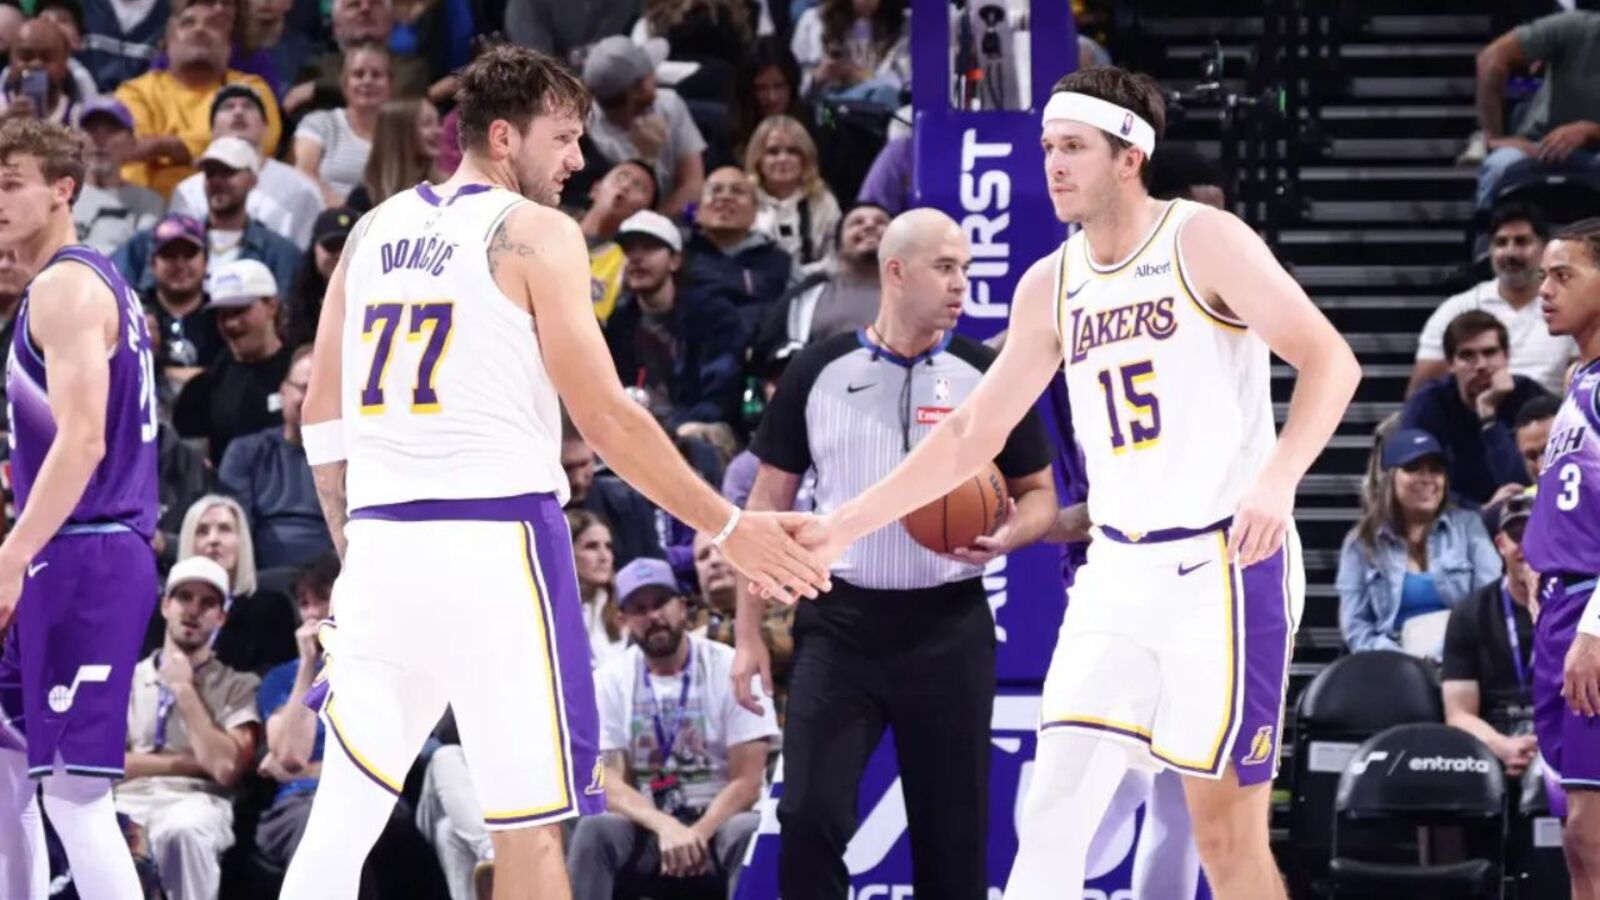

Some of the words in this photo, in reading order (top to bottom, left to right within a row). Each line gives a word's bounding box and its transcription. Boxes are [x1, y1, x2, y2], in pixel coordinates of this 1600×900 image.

[960, 128, 1013, 319] FIRST
[1134, 261, 1172, 278] Albert
[359, 299, 455, 415] 77
[1070, 296, 1178, 365] LAKERS
[1097, 359, 1162, 455] 15
[1556, 463, 1582, 511] 3
[1409, 755, 1489, 773] entrata
